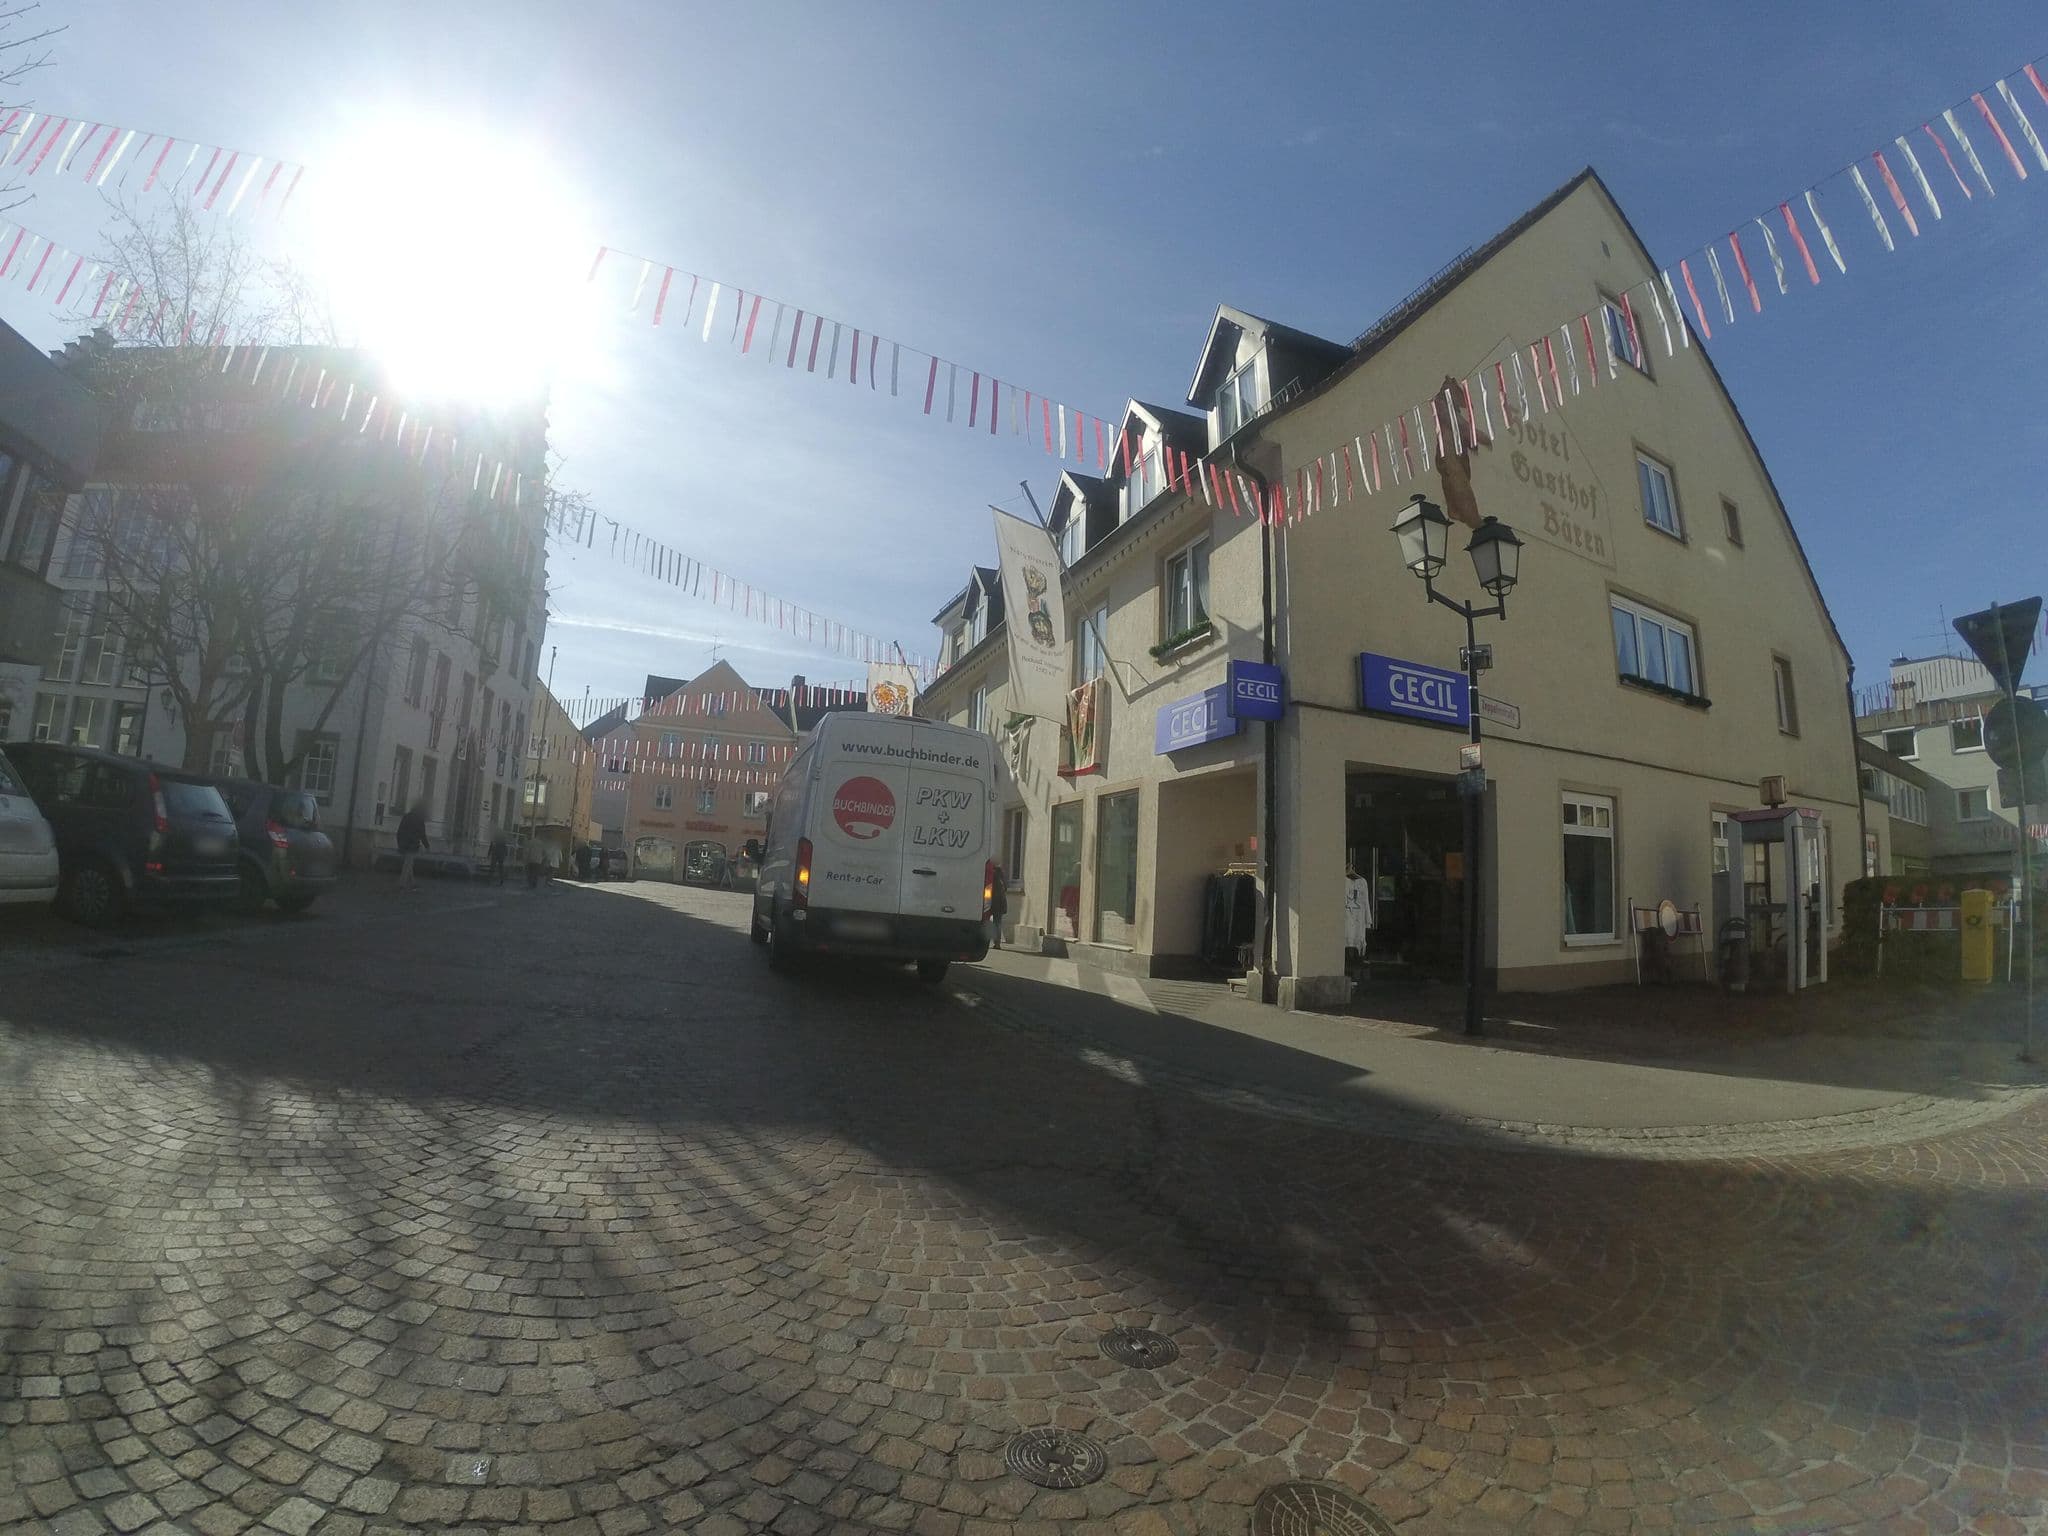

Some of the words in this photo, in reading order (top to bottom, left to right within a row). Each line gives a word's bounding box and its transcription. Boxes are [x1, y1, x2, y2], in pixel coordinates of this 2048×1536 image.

[1511, 451, 1597, 520] Gasthof
[1237, 681, 1279, 700] CECIL
[1389, 673, 1458, 711] CECIL
[1170, 702, 1218, 739] CECIL
[841, 741, 980, 769] www.buchbinder.de
[833, 798, 896, 817] BUCHBINDER
[915, 786, 972, 810] PKW
[912, 825, 969, 848] LKW
[826, 871, 884, 886] Rent-a-Car
